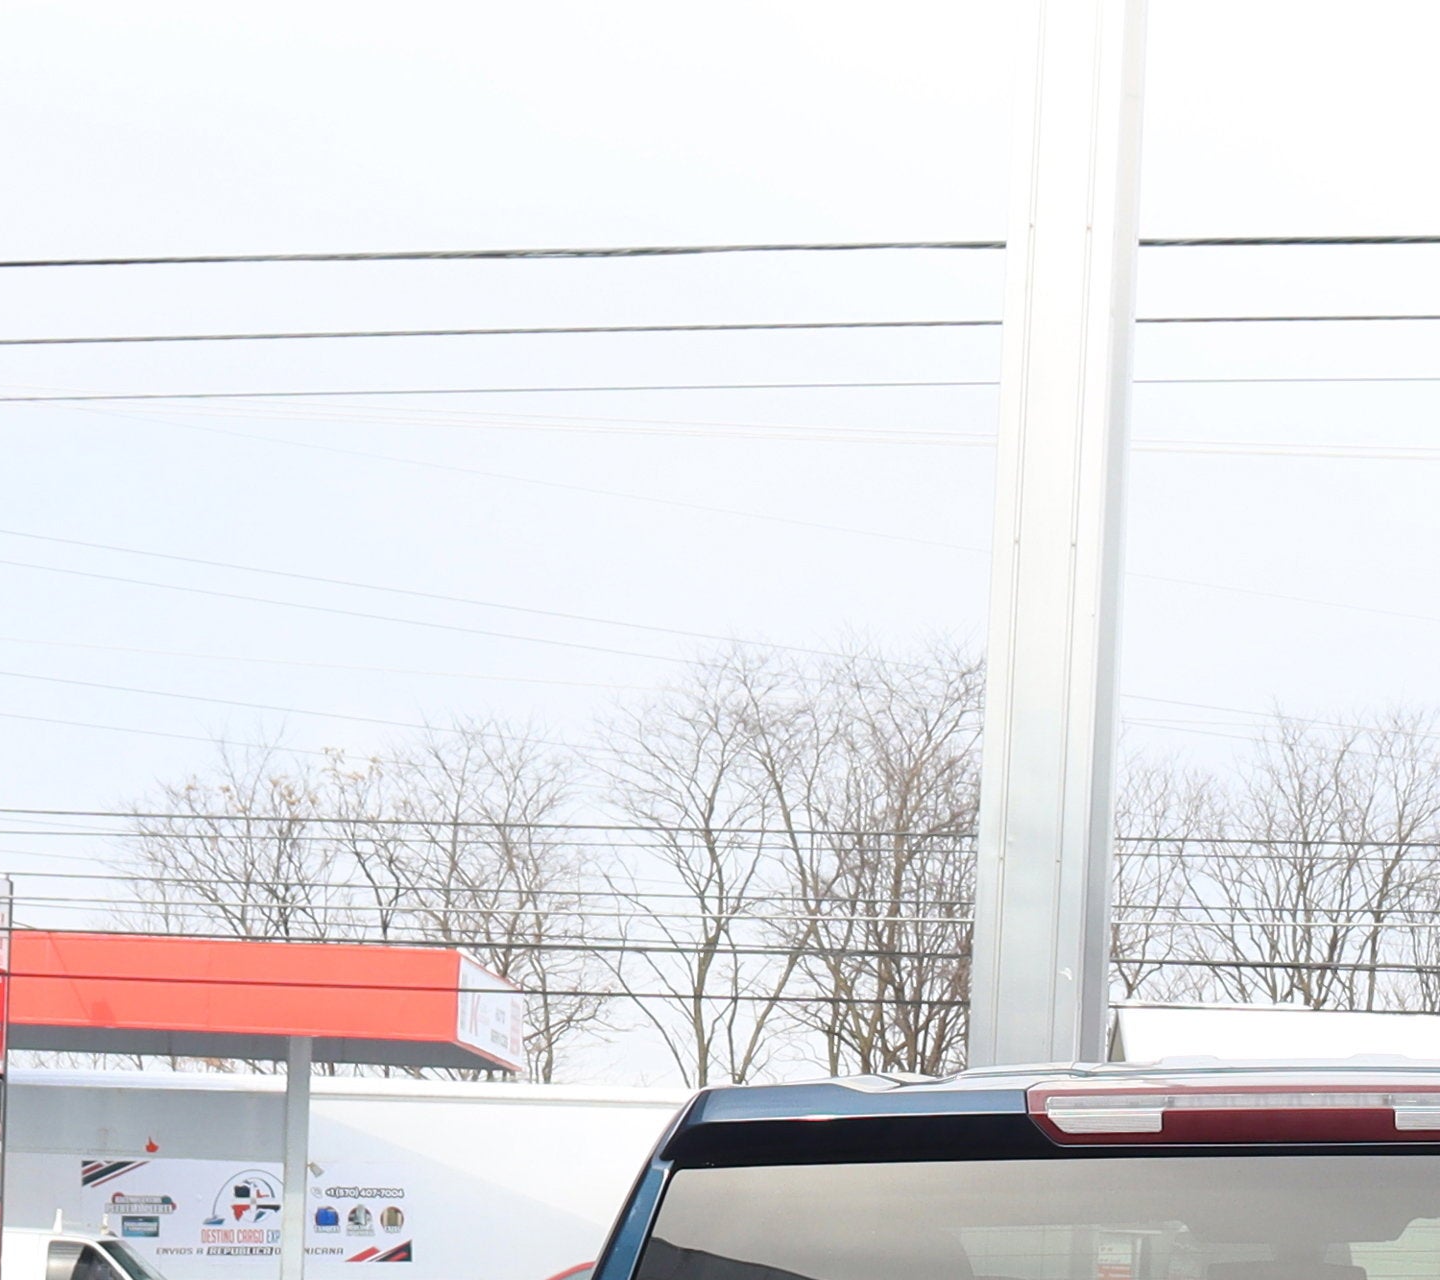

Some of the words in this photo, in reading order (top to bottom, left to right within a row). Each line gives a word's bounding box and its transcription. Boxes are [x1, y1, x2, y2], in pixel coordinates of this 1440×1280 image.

[201, 1229, 235, 1243] DESTINO
[236, 1229, 264, 1243] CARGO
[267, 1230, 281, 1243] EXP
[156, 1247, 193, 1255] ENVIOS
[208, 1246, 273, 1255] REPUBLICA
